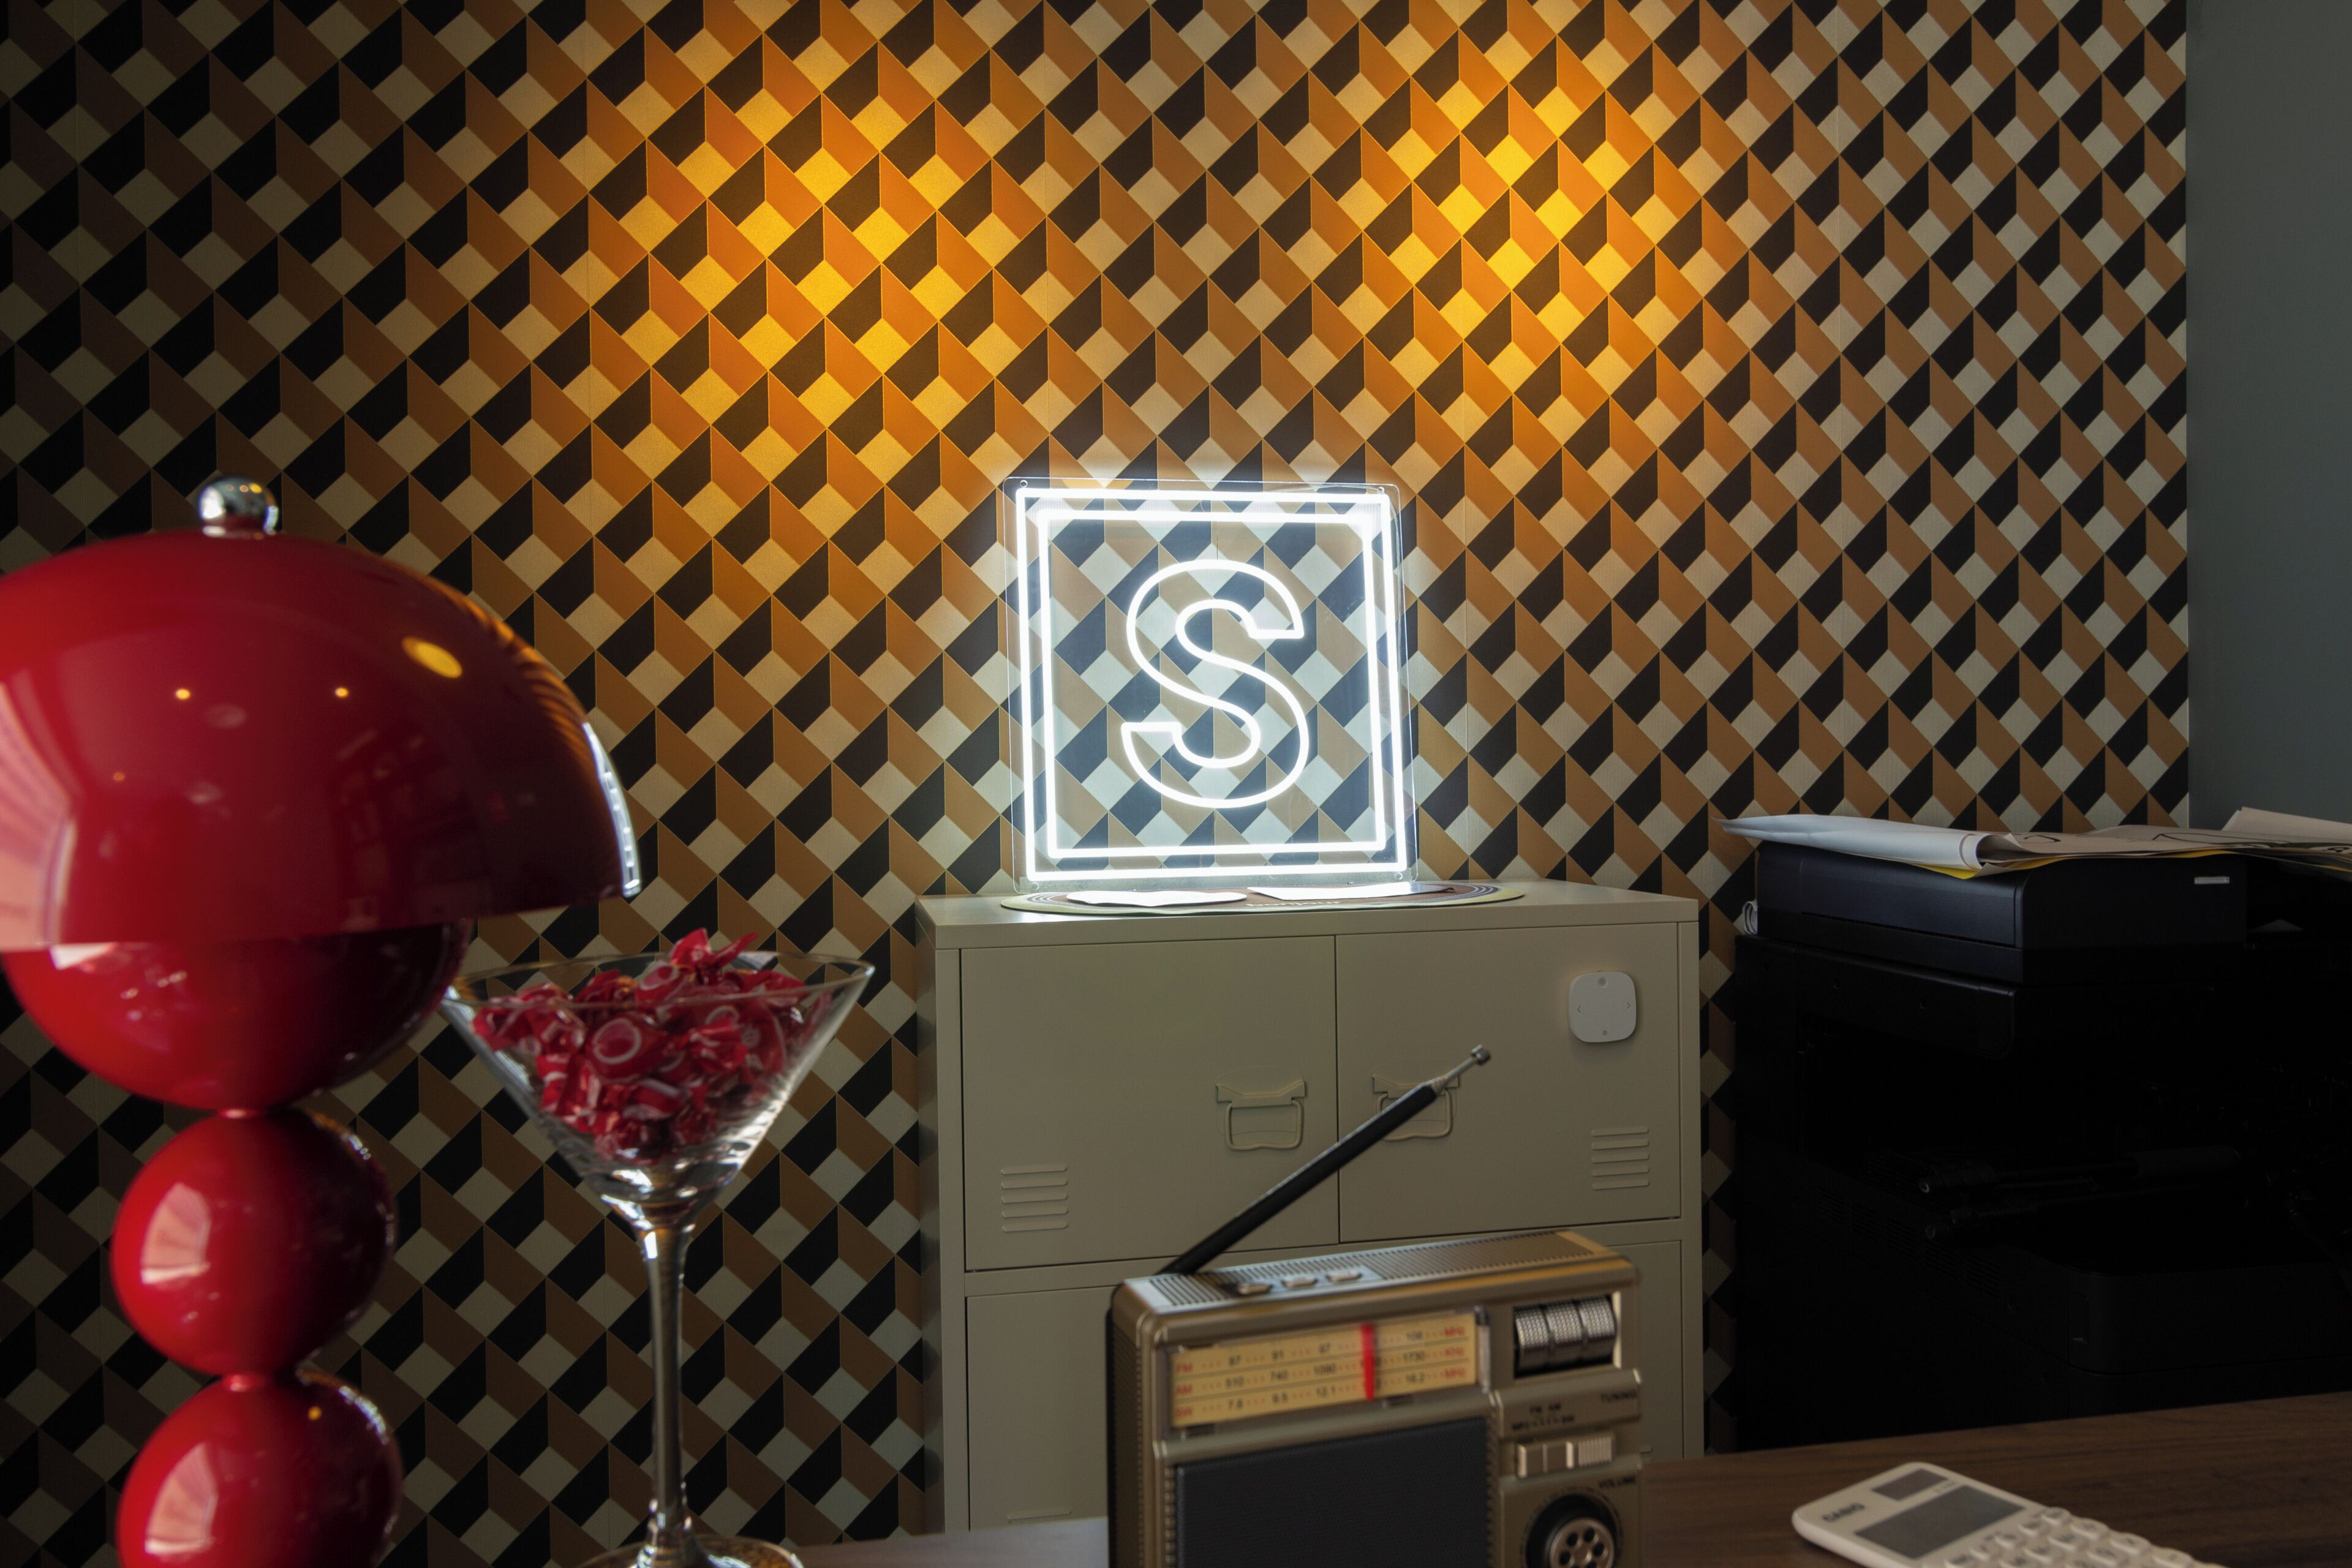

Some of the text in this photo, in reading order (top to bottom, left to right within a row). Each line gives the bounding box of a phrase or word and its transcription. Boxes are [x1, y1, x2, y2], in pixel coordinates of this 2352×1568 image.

[1121, 559, 1310, 810] S
[1176, 1363, 1193, 1373] FM
[1229, 1355, 1241, 1366] 87
[1272, 1349, 1284, 1360] 91
[1406, 1331, 1422, 1341] 108
[1176, 1384, 1193, 1395] AM
[1600, 1389, 1637, 1403] TUNING
[1176, 1406, 1193, 1417] SW
[1598, 1476, 1636, 1489] VOLUME
[1822, 1502, 1866, 1523] CASIO
